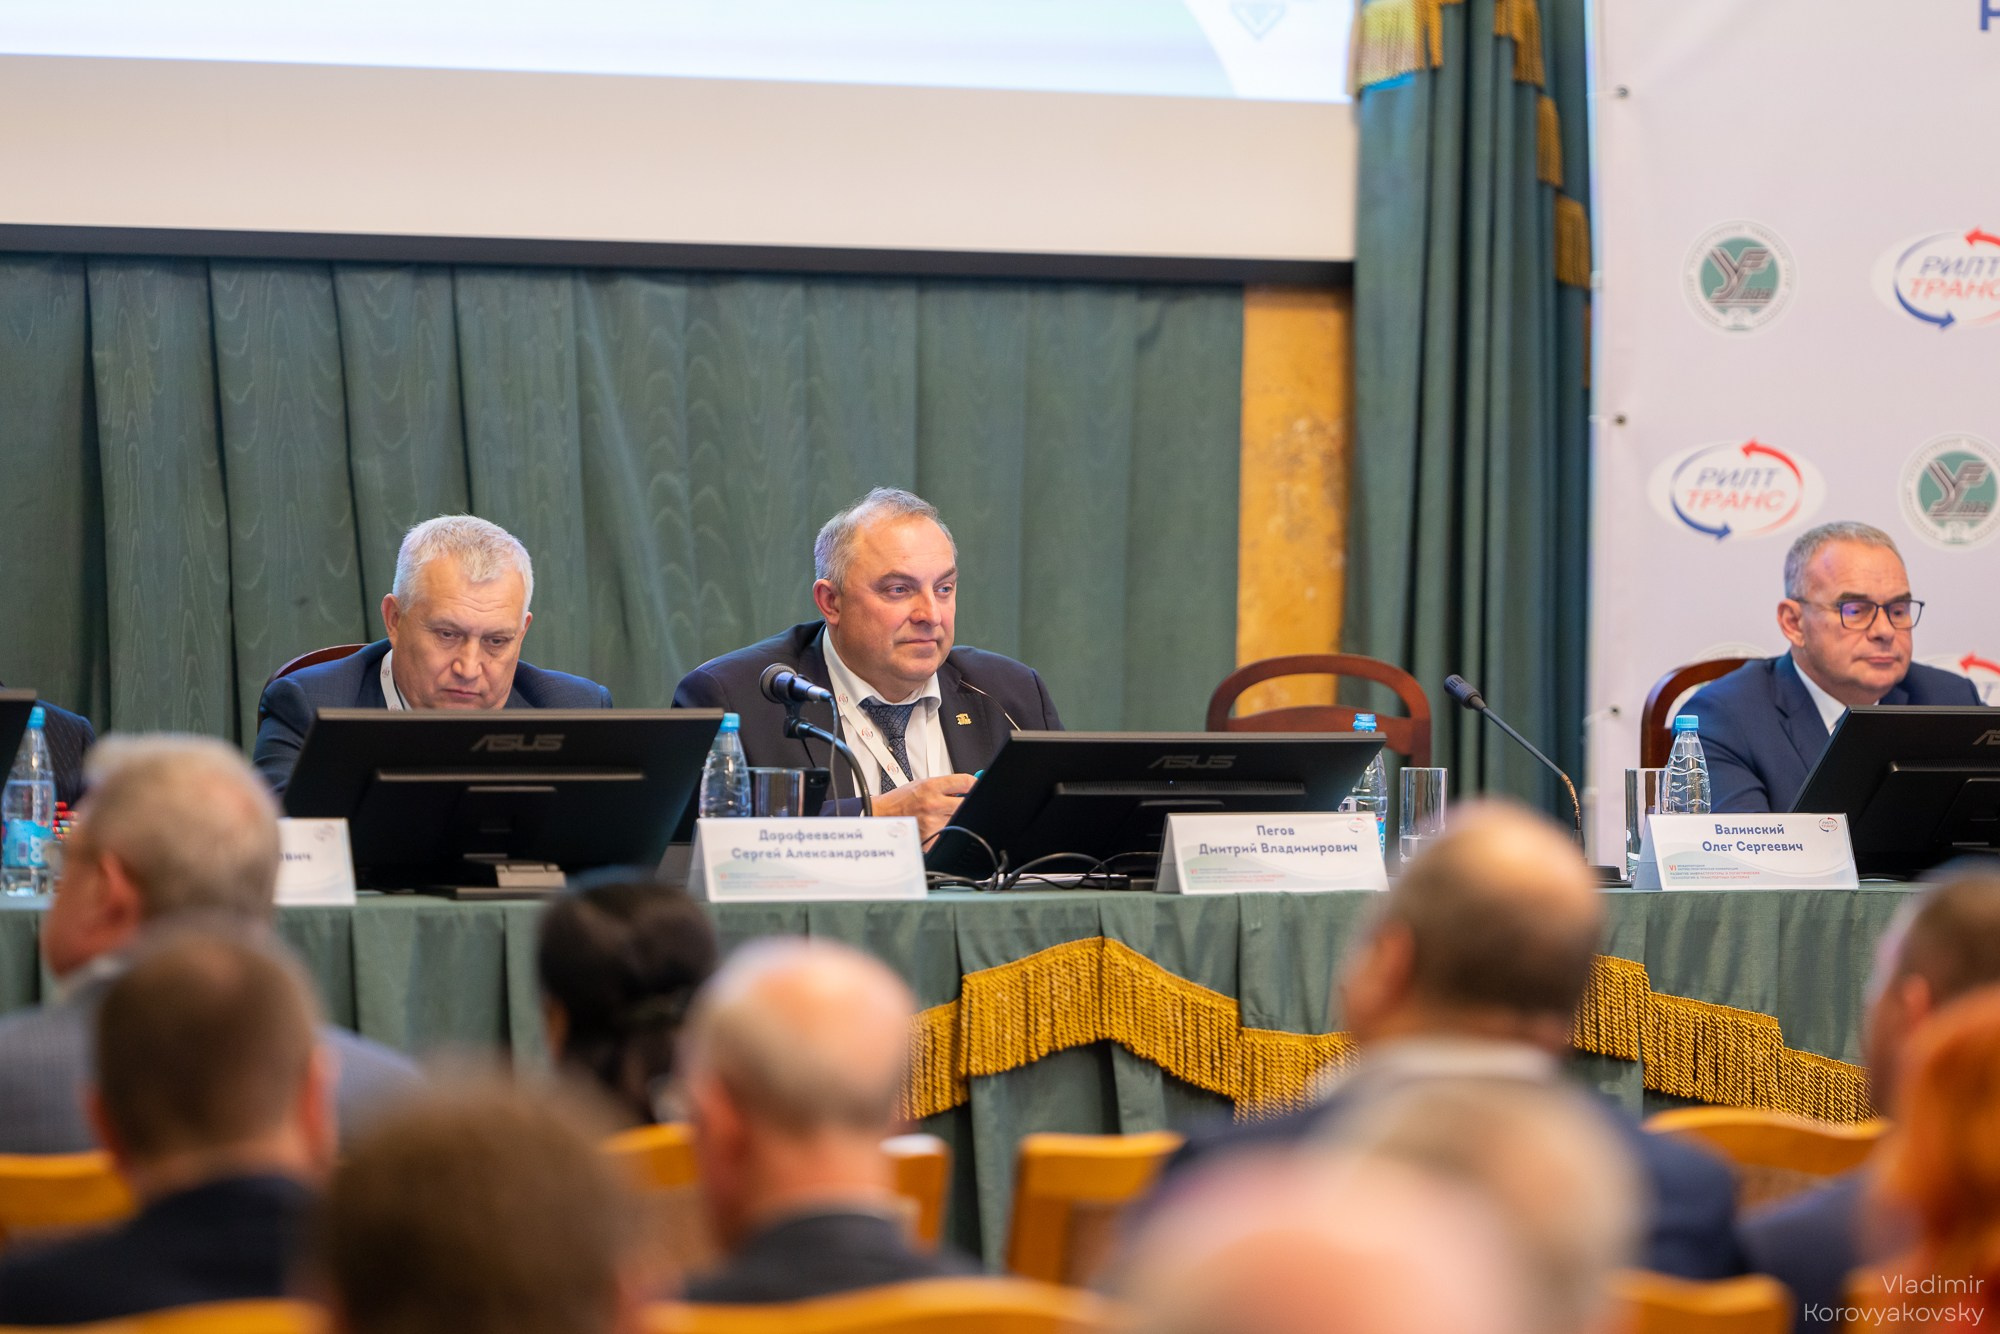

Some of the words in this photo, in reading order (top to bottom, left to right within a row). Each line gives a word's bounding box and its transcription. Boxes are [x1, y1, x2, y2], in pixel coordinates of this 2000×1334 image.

[1696, 467, 1779, 488] РИЛТ
[1685, 489, 1787, 511] ТРАНС
[469, 734, 565, 751] ASUS
[1147, 755, 1237, 769] ASUS
[1256, 825, 1295, 836] Пегов
[1714, 823, 1785, 835] Валинский
[758, 829, 863, 844] Дорофеевский
[731, 848, 781, 861] Сергей
[785, 848, 895, 860] Александрович
[1199, 843, 1258, 857] Дмитрий
[1261, 843, 1358, 856] Владимирович
[1702, 841, 1733, 852] Олег
[1736, 841, 1804, 854] Сергеевич
